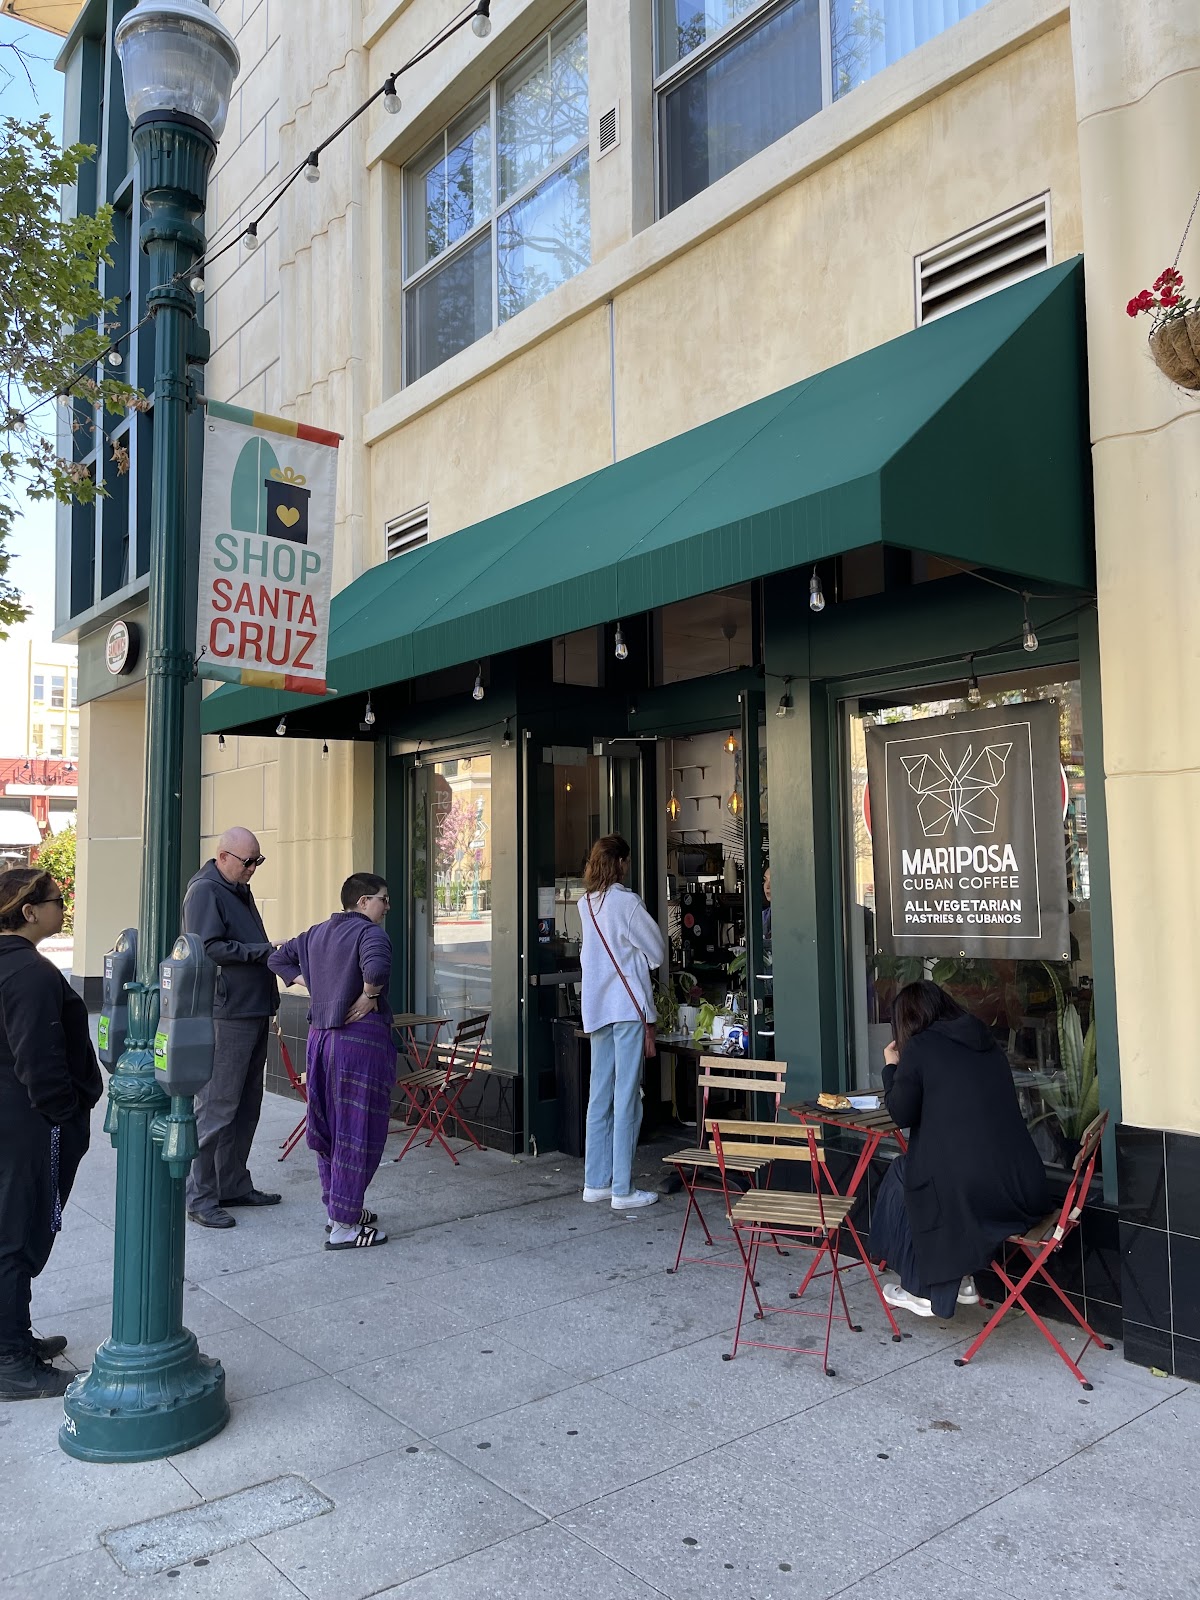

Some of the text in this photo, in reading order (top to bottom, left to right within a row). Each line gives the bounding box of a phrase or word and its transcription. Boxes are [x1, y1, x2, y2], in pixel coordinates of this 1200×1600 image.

[213, 533, 321, 585] SHOP
[211, 578, 318, 627] SANTA
[209, 617, 317, 670] CRUZ
[902, 844, 1019, 875] MARIPOSA
[903, 876, 1020, 891] CUBAN COFFEE
[904, 899, 1022, 912] ALL VEGETARIAN
[905, 914, 1022, 924] PASTRIES & CUBANOS
